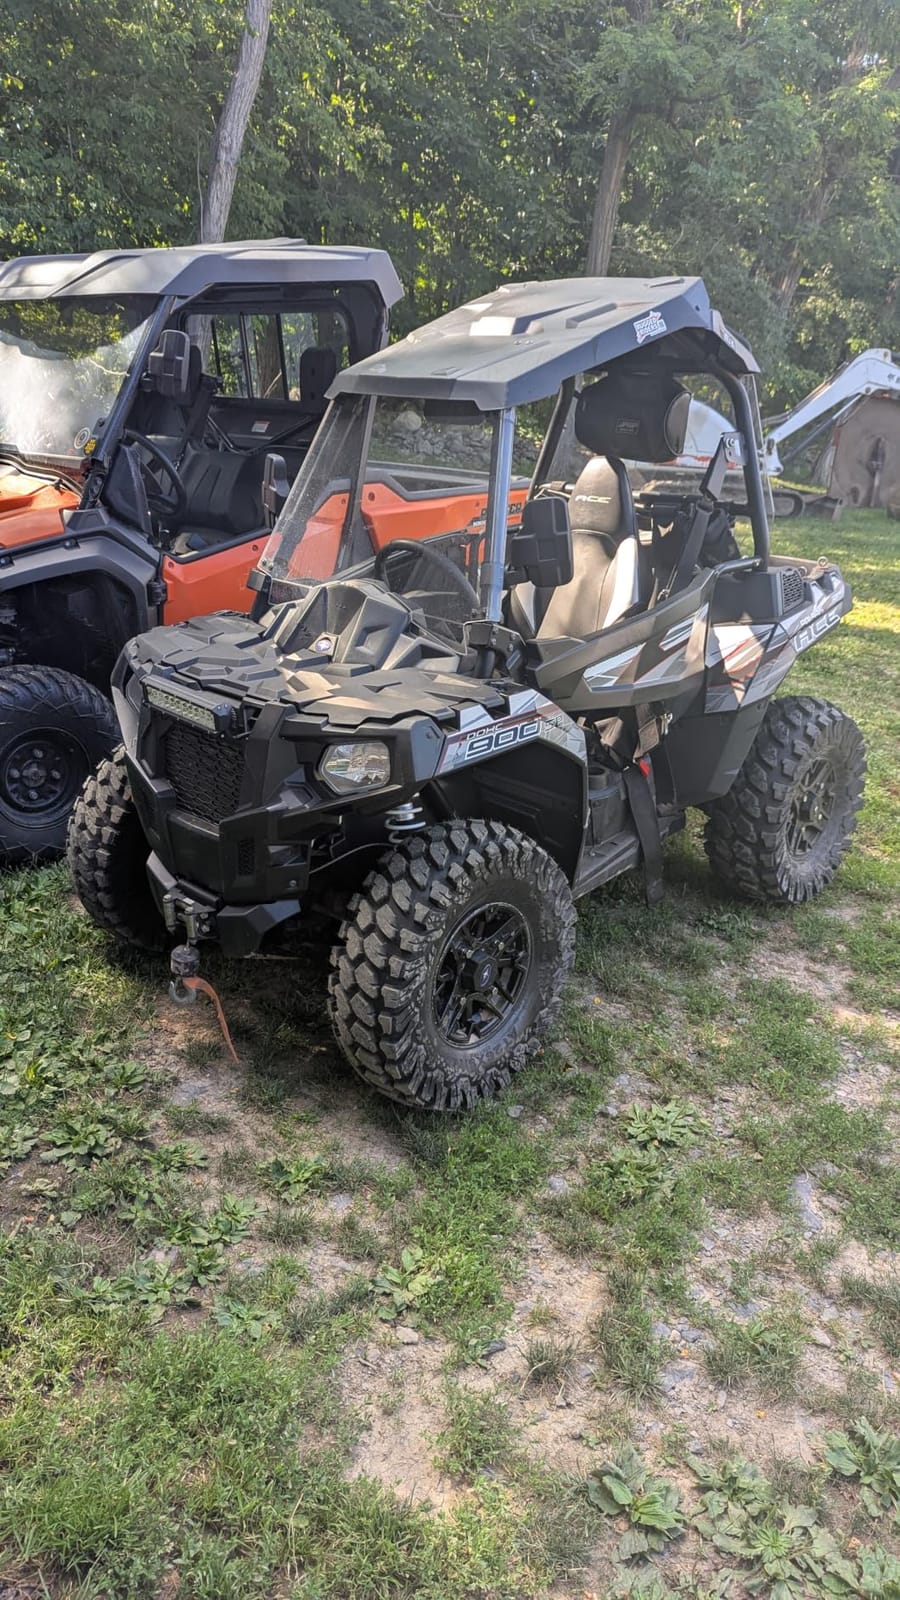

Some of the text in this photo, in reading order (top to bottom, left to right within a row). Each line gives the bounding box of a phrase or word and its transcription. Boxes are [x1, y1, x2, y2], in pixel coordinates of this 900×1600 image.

[575, 495, 612, 504] ACE
[794, 605, 840, 652] ACE
[465, 718, 541, 760] 900
[466, 722, 503, 740] DOHC
